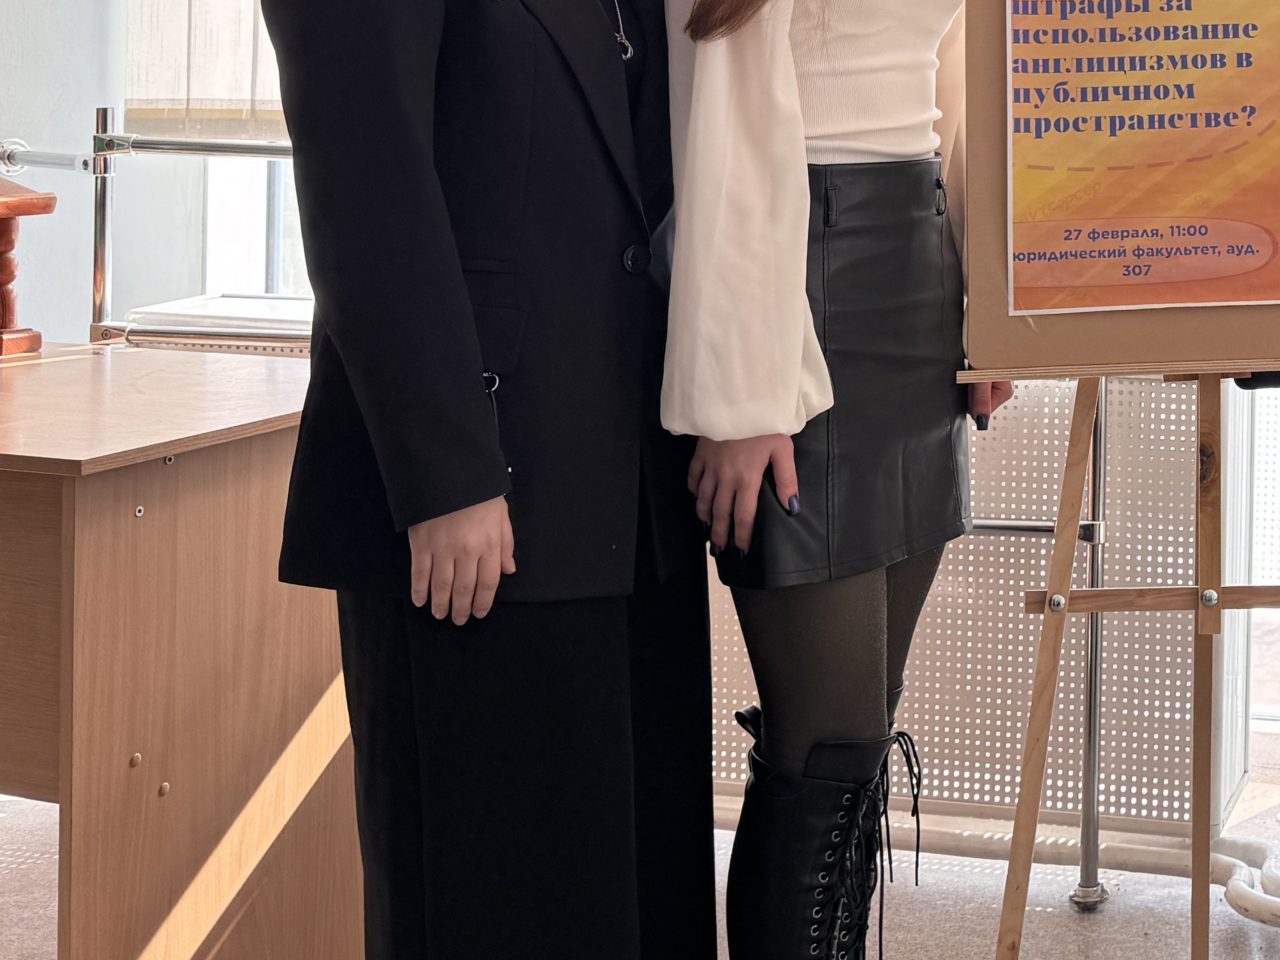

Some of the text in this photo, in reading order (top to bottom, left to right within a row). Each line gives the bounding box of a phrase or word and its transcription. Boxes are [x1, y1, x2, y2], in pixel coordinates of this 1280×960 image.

[1012, 22, 1259, 44] использование
[1012, 52, 1254, 75] англицизмов в
[1013, 81, 1196, 109] публичном
[1013, 105, 1258, 139] пространстве?
[1063, 225, 1209, 242] 27 февраля, 11:00
[1013, 243, 1261, 262] юридический факультет, ауд.
[1121, 264, 1153, 278] 307
